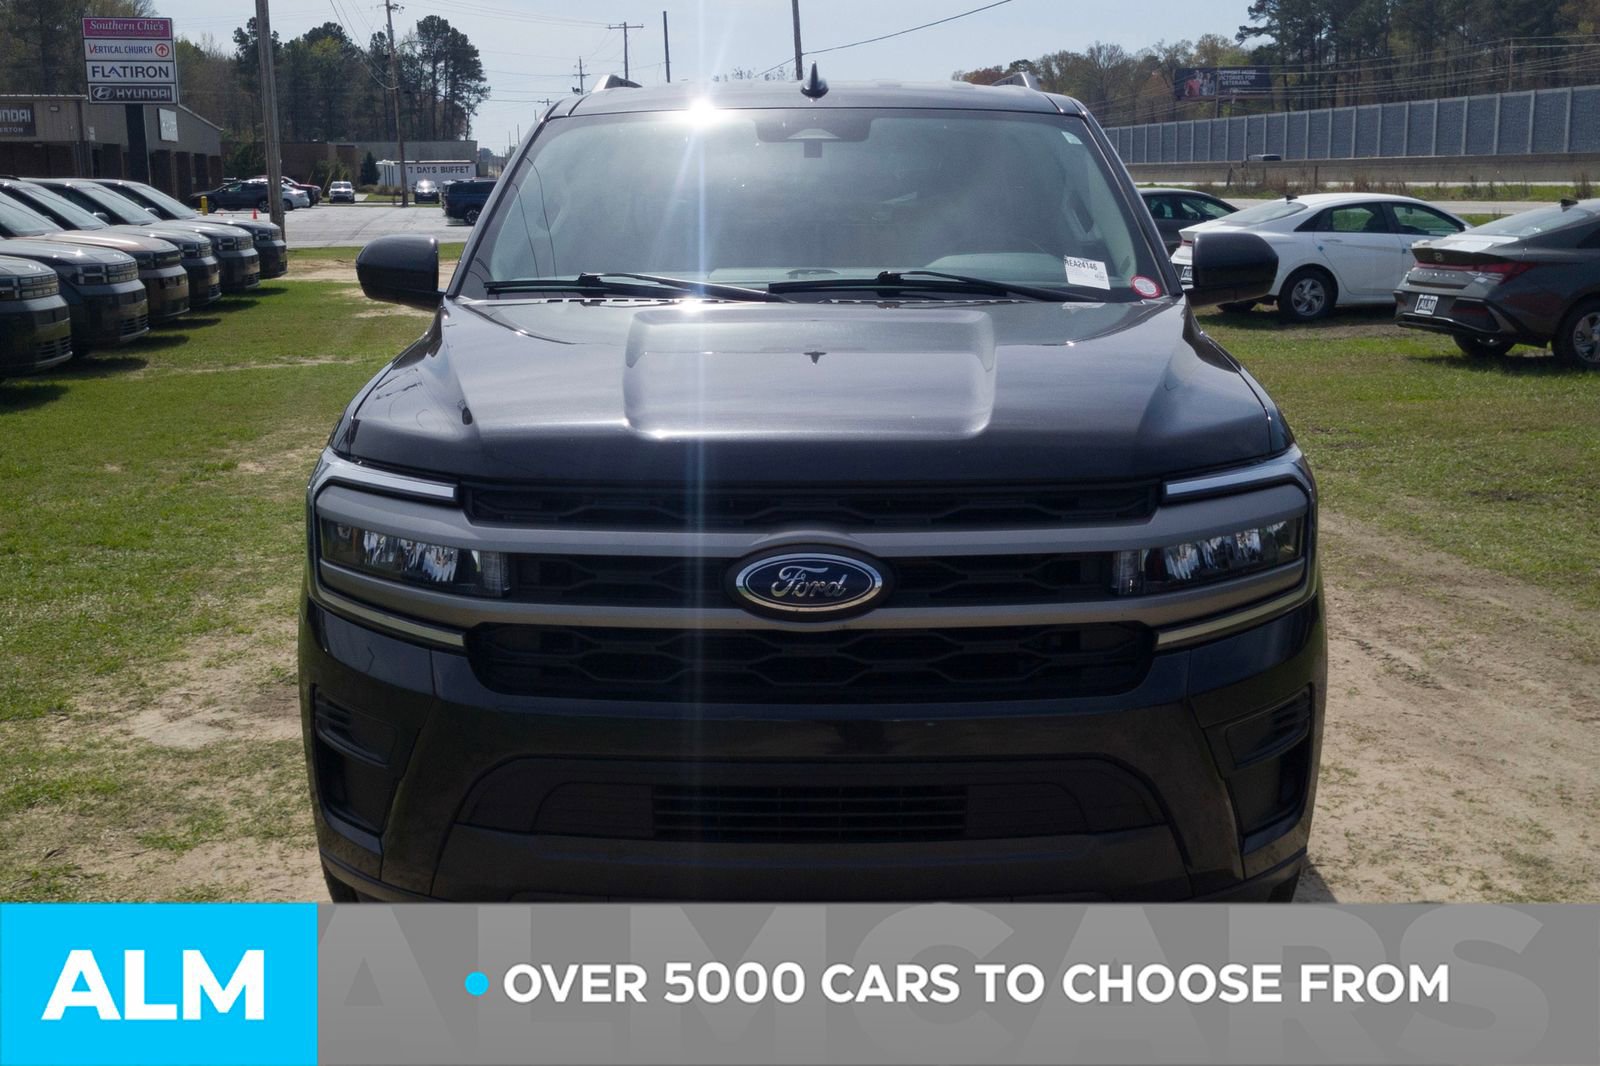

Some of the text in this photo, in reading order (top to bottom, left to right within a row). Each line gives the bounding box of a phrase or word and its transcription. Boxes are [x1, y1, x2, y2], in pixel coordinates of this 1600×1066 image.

[90, 20, 135, 30] Southern
[88, 44, 153, 54] VERTICAL CHURCH
[91, 66, 169, 78] FLATIRON
[116, 88, 171, 99] HYUNDAI
[0, 109, 31, 122] NDAI
[416, 166, 437, 174] DAYS
[440, 166, 470, 174] BUFFET
[770, 565, 848, 598] Ford
